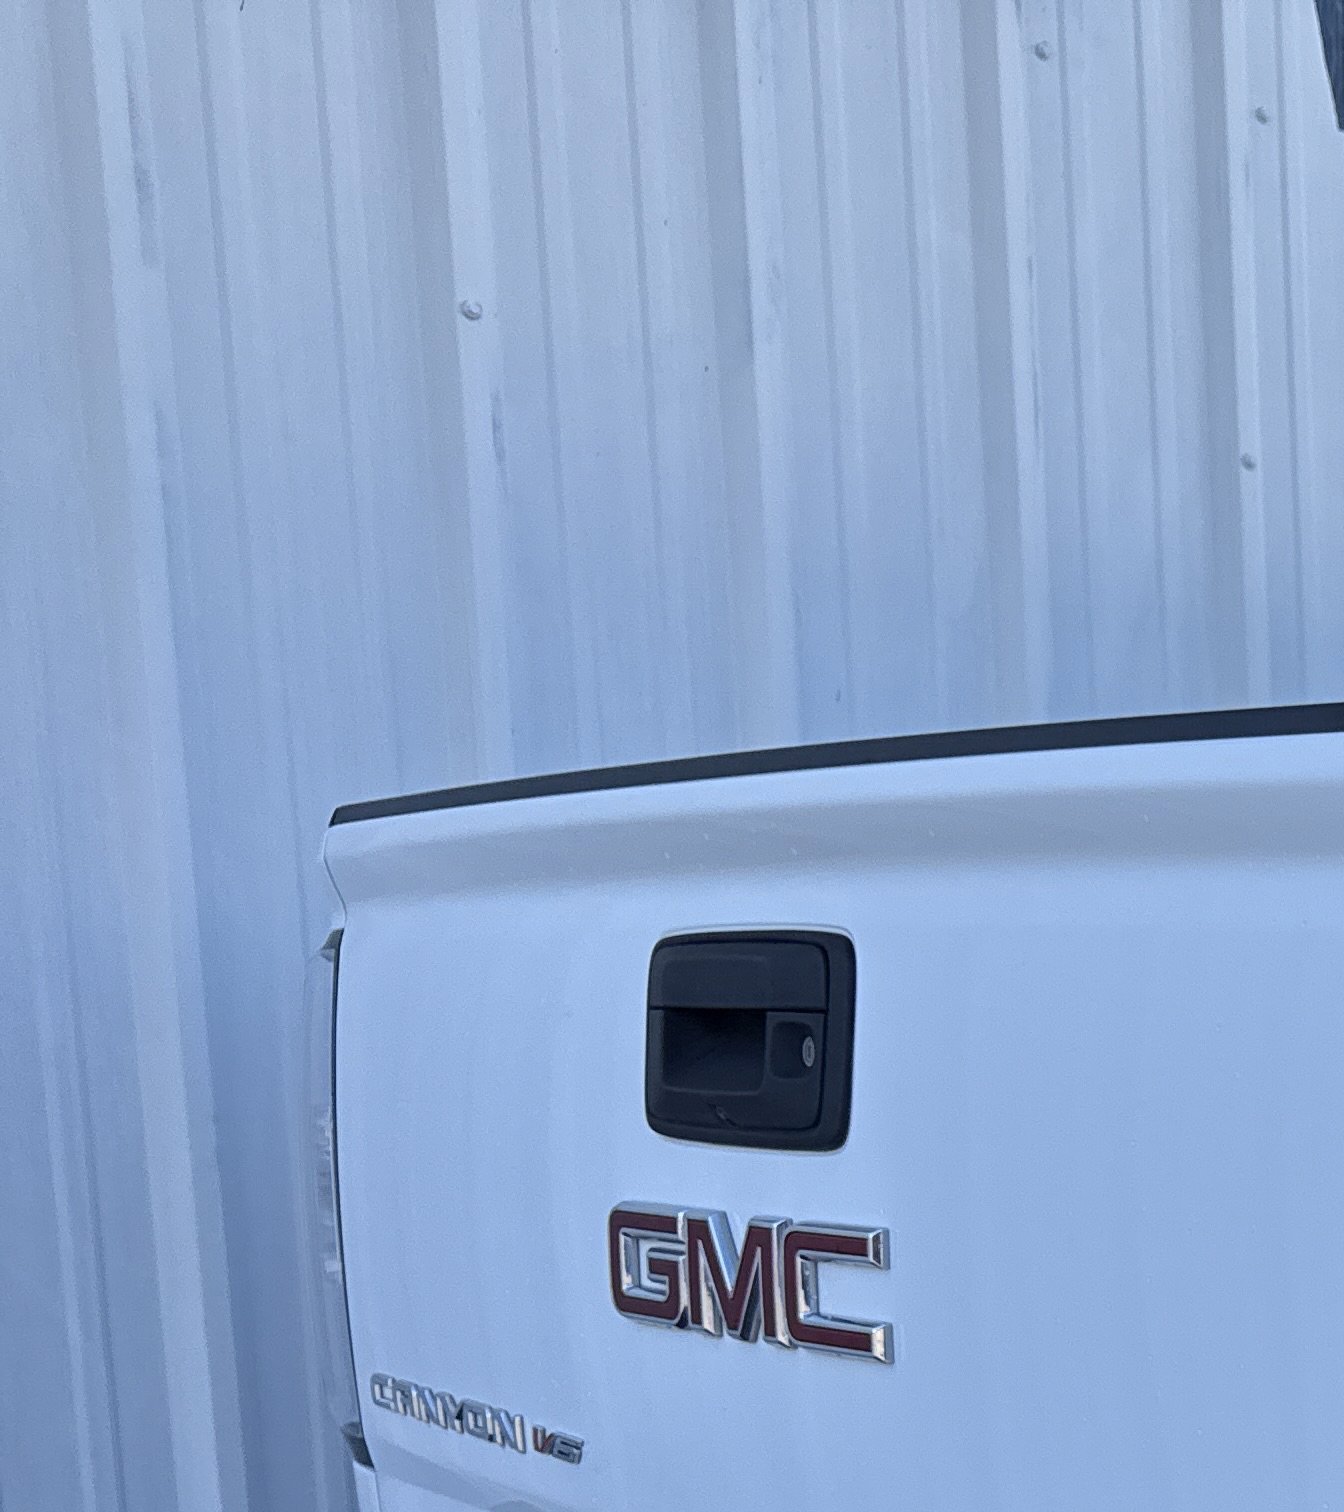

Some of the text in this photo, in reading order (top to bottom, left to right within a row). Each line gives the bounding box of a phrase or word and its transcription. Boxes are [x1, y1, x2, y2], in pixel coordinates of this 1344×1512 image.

[608, 1200, 895, 1364] GMC
[369, 1372, 585, 1465] CANYON V6
